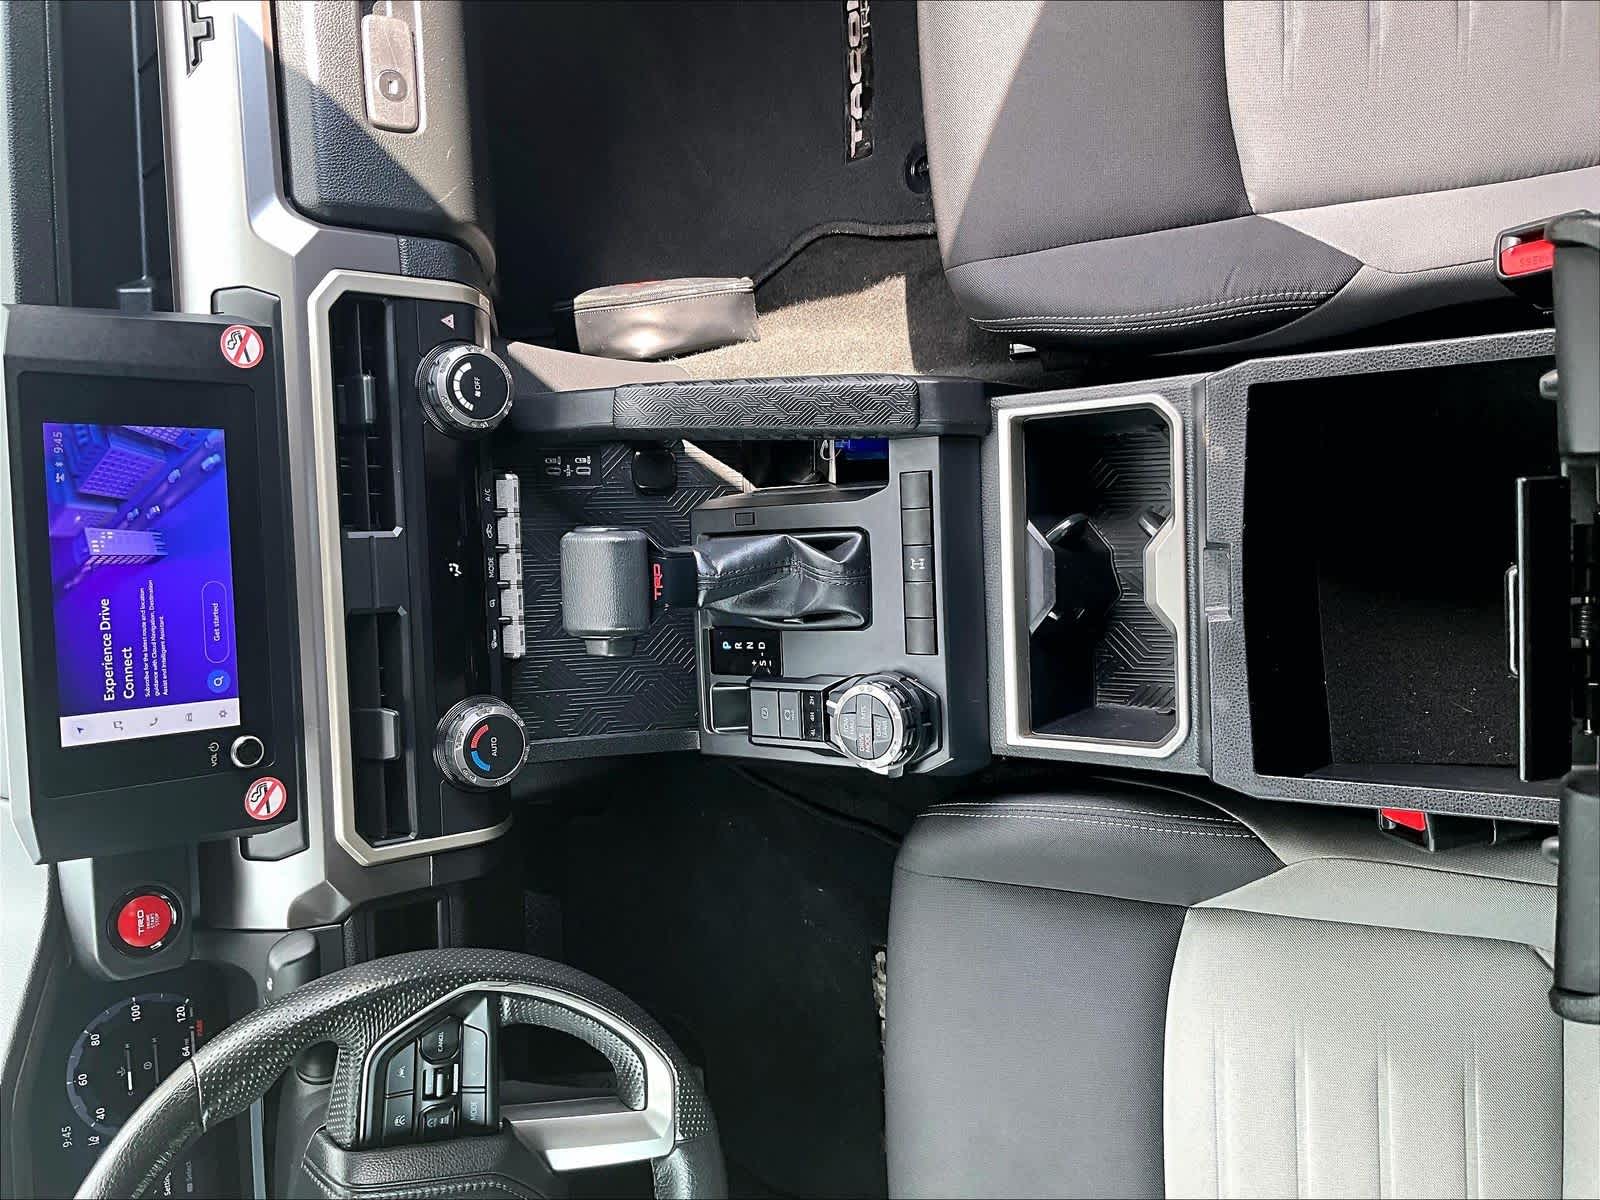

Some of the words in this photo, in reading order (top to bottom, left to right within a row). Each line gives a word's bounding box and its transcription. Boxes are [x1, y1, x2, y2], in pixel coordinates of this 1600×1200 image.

[52, 431, 64, 454] 9:45
[653, 564, 664, 600] TRD
[99, 598, 110, 631] Drive
[212, 603, 220, 628] started
[158, 616, 166, 640] Assistant
[150, 642, 158, 658] Cloud
[159, 640, 168, 668] Intelligent
[722, 641, 732, 650] P
[734, 642, 742, 650] R
[746, 642, 754, 650] N
[758, 642, 766, 650] D
[102, 632, 116, 701] Experience
[121, 646, 134, 699] Connect
[142, 662, 150, 670] for
[160, 668, 168, 679] and
[152, 671, 160, 696] guidance
[490, 736, 498, 756] AUTO
[210, 752, 218, 767] VOL
[130, 1004, 140, 1022] 100
[176, 1006, 186, 1023] 120
[91, 1034, 100, 1046] 80
[182, 1046, 190, 1057] 64
[78, 1074, 88, 1086] 60
[96, 1108, 106, 1120] 40
[62, 1126, 72, 1148] 9:45
